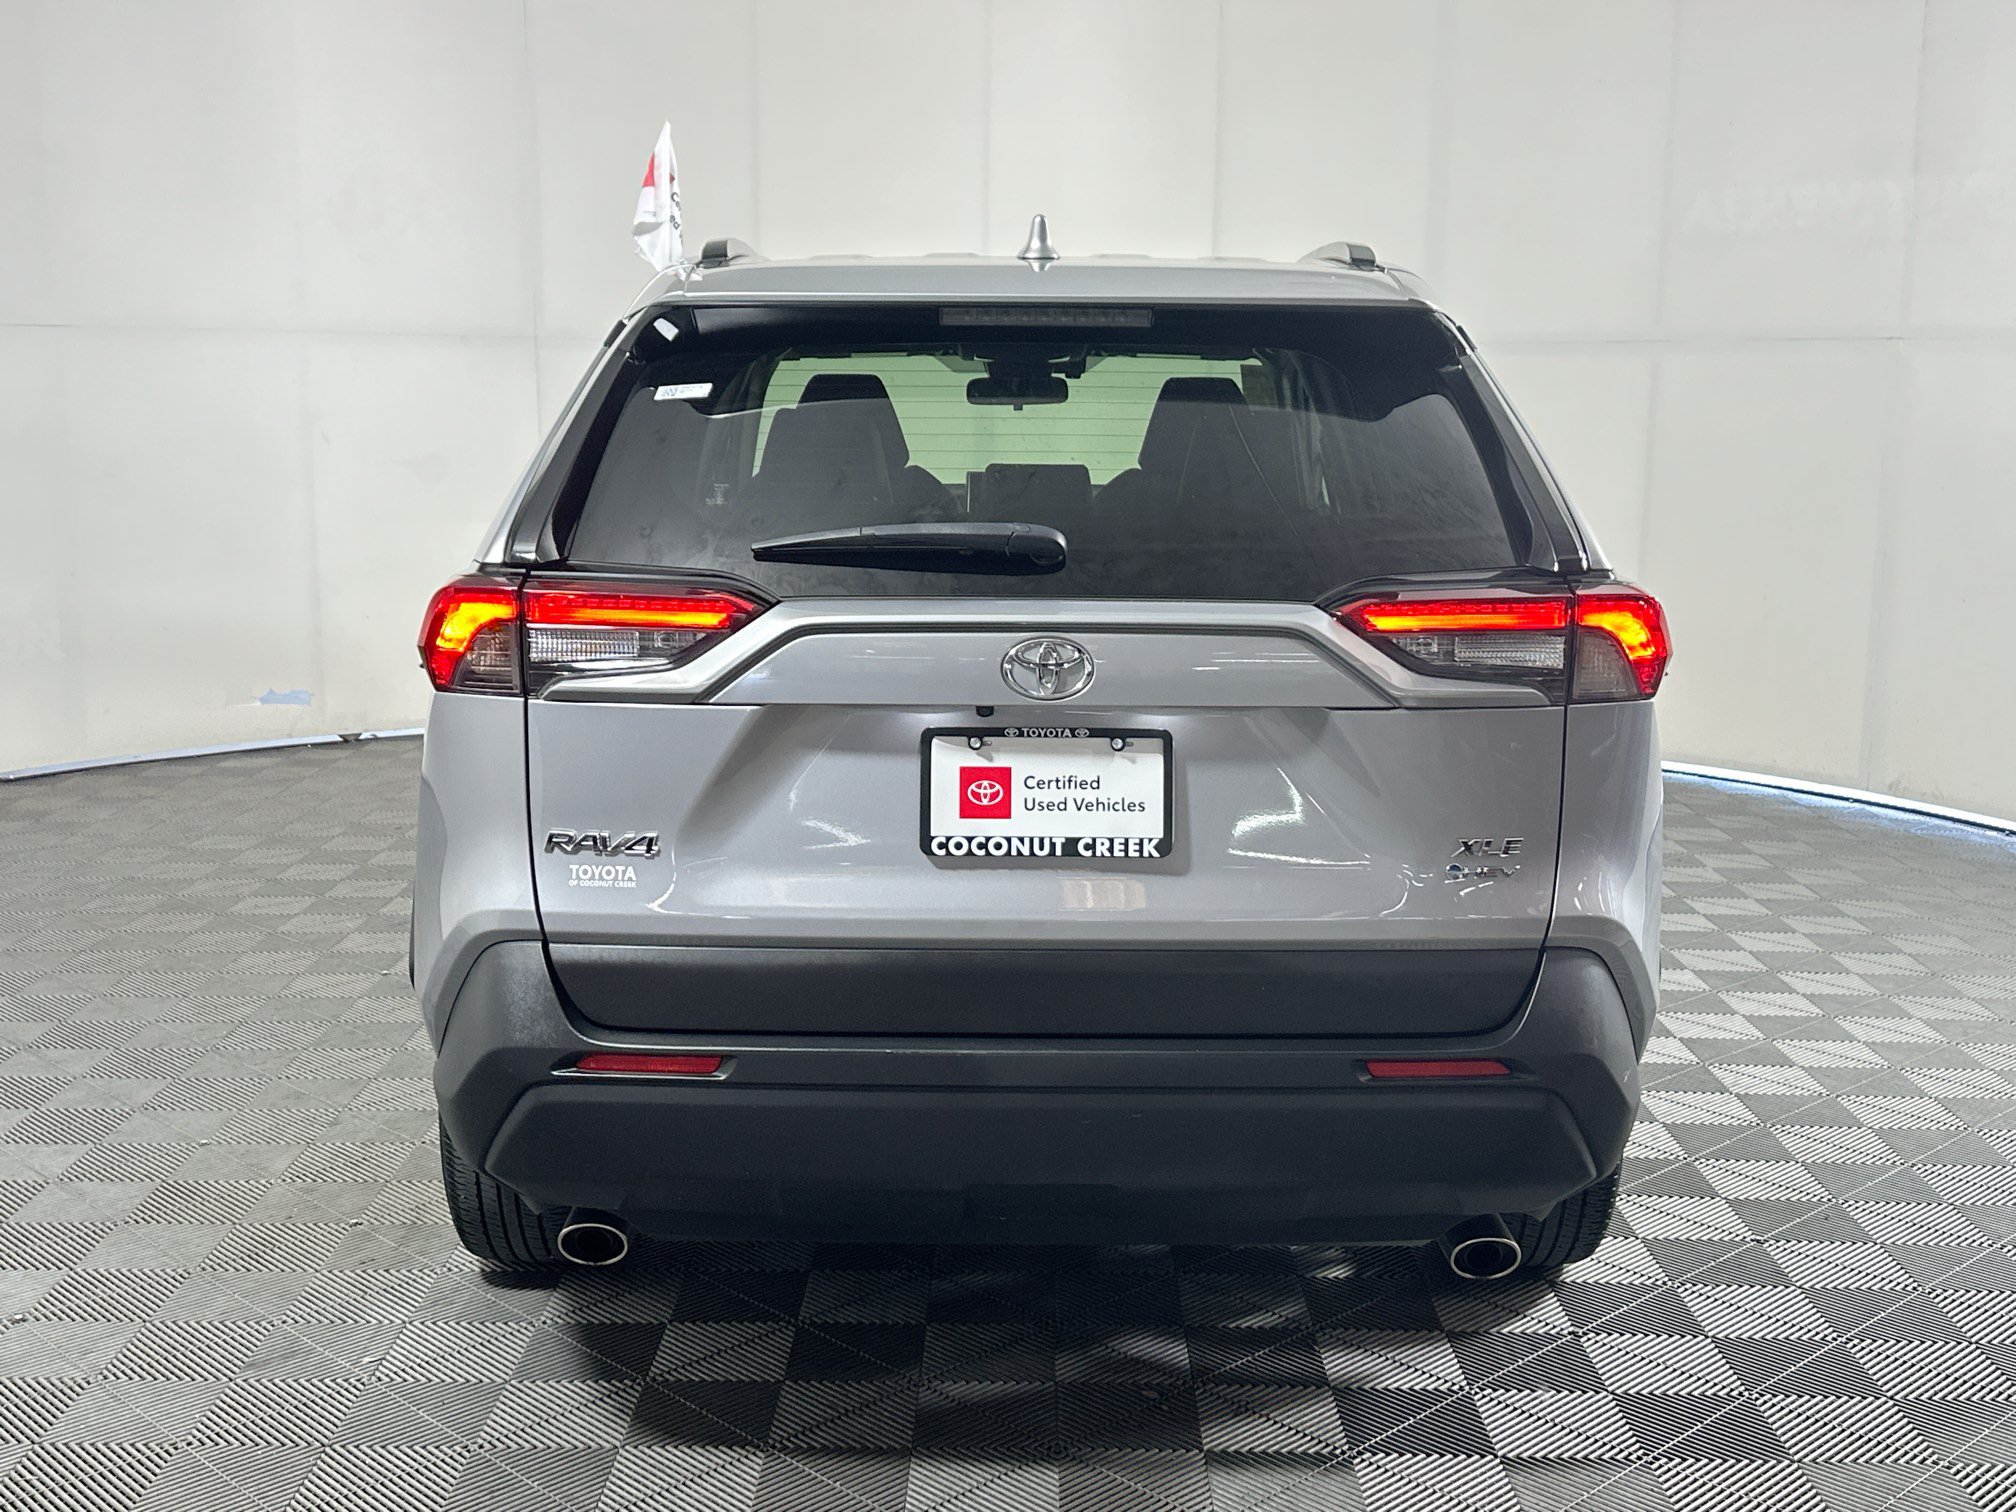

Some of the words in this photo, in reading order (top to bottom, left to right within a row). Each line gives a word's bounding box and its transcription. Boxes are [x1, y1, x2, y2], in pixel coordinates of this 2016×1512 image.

[1021, 728, 1073, 738] TOYOTA
[1023, 775, 1101, 790] Certified
[1023, 797, 1068, 812] Used
[1073, 797, 1146, 812] Vehicles
[544, 829, 660, 858] RAV4
[931, 836, 1066, 856] COCONUT
[1077, 837, 1161, 858] CREEK
[1451, 837, 1524, 857] XLE
[569, 864, 637, 881] TOYOTA
[579, 880, 614, 888] COCONUT
[614, 880, 637, 888] CREEK
